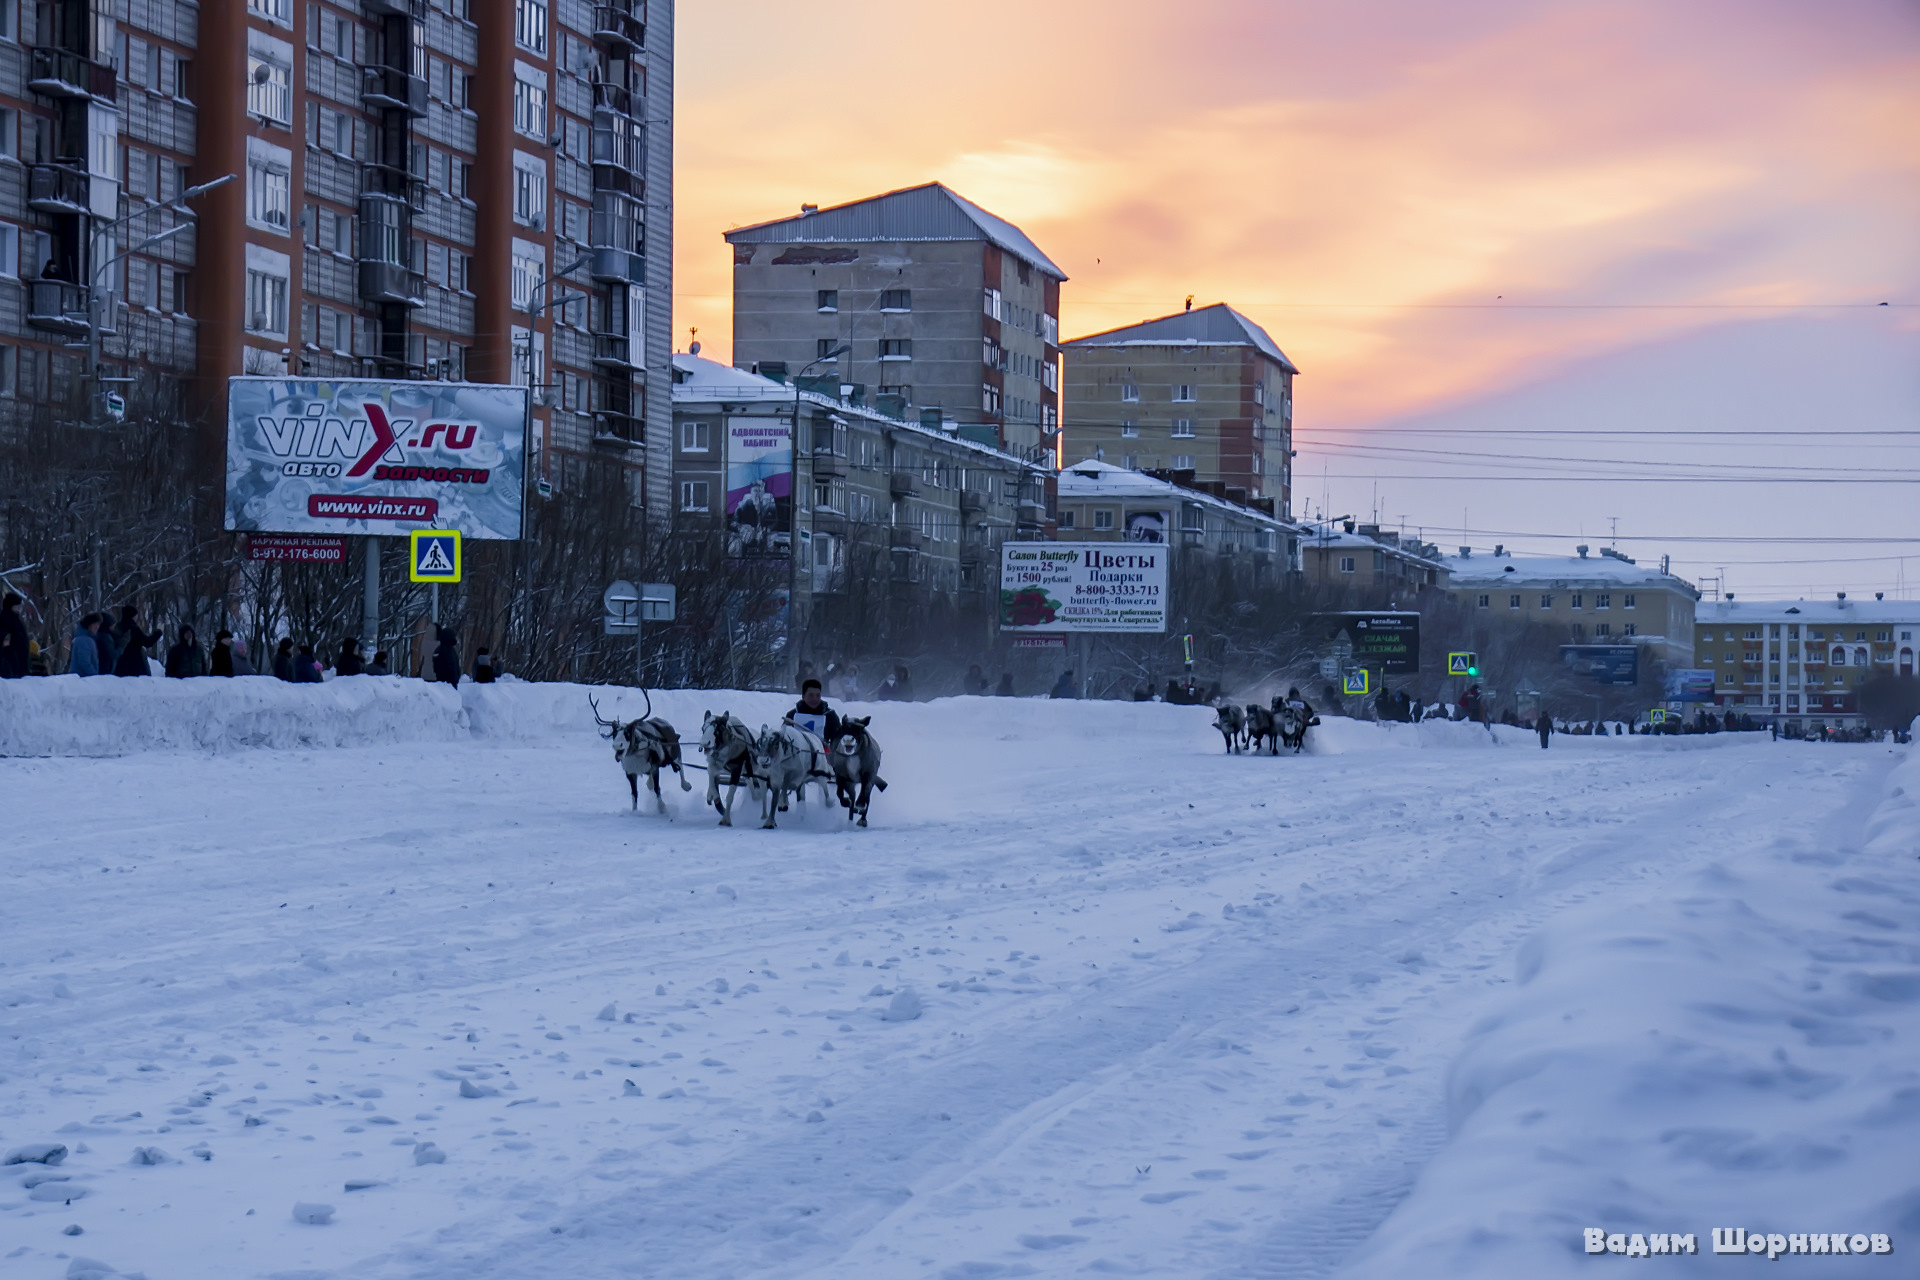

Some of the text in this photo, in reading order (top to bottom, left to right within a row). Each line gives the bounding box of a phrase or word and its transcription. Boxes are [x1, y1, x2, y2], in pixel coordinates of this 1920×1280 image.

[732, 427, 789, 437] АДВОКАТСКИЙ
[743, 439, 778, 448] КАБИНЕТ
[282, 462, 490, 484] авто запчасти
[317, 500, 427, 517] www.vinx.ru
[251, 538, 342, 546] НАРУЖНАЯ РЕКЛАМА
[1008, 550, 1079, 563] Салон Butterfly
[1084, 550, 1155, 571] Цветы
[1006, 564, 1028, 572] Букет
[1041, 561, 1053, 571] 25
[1017, 573, 1042, 582] 1500
[1043, 575, 1072, 584] рублей!
[1089, 570, 1143, 585] Подарки
[1075, 585, 1159, 595] 8-800-3333-713
[1070, 596, 1157, 607] butterfly-flower.ru
[1064, 606, 1090, 615] СКИДКА
[1119, 609, 1162, 617] работников
